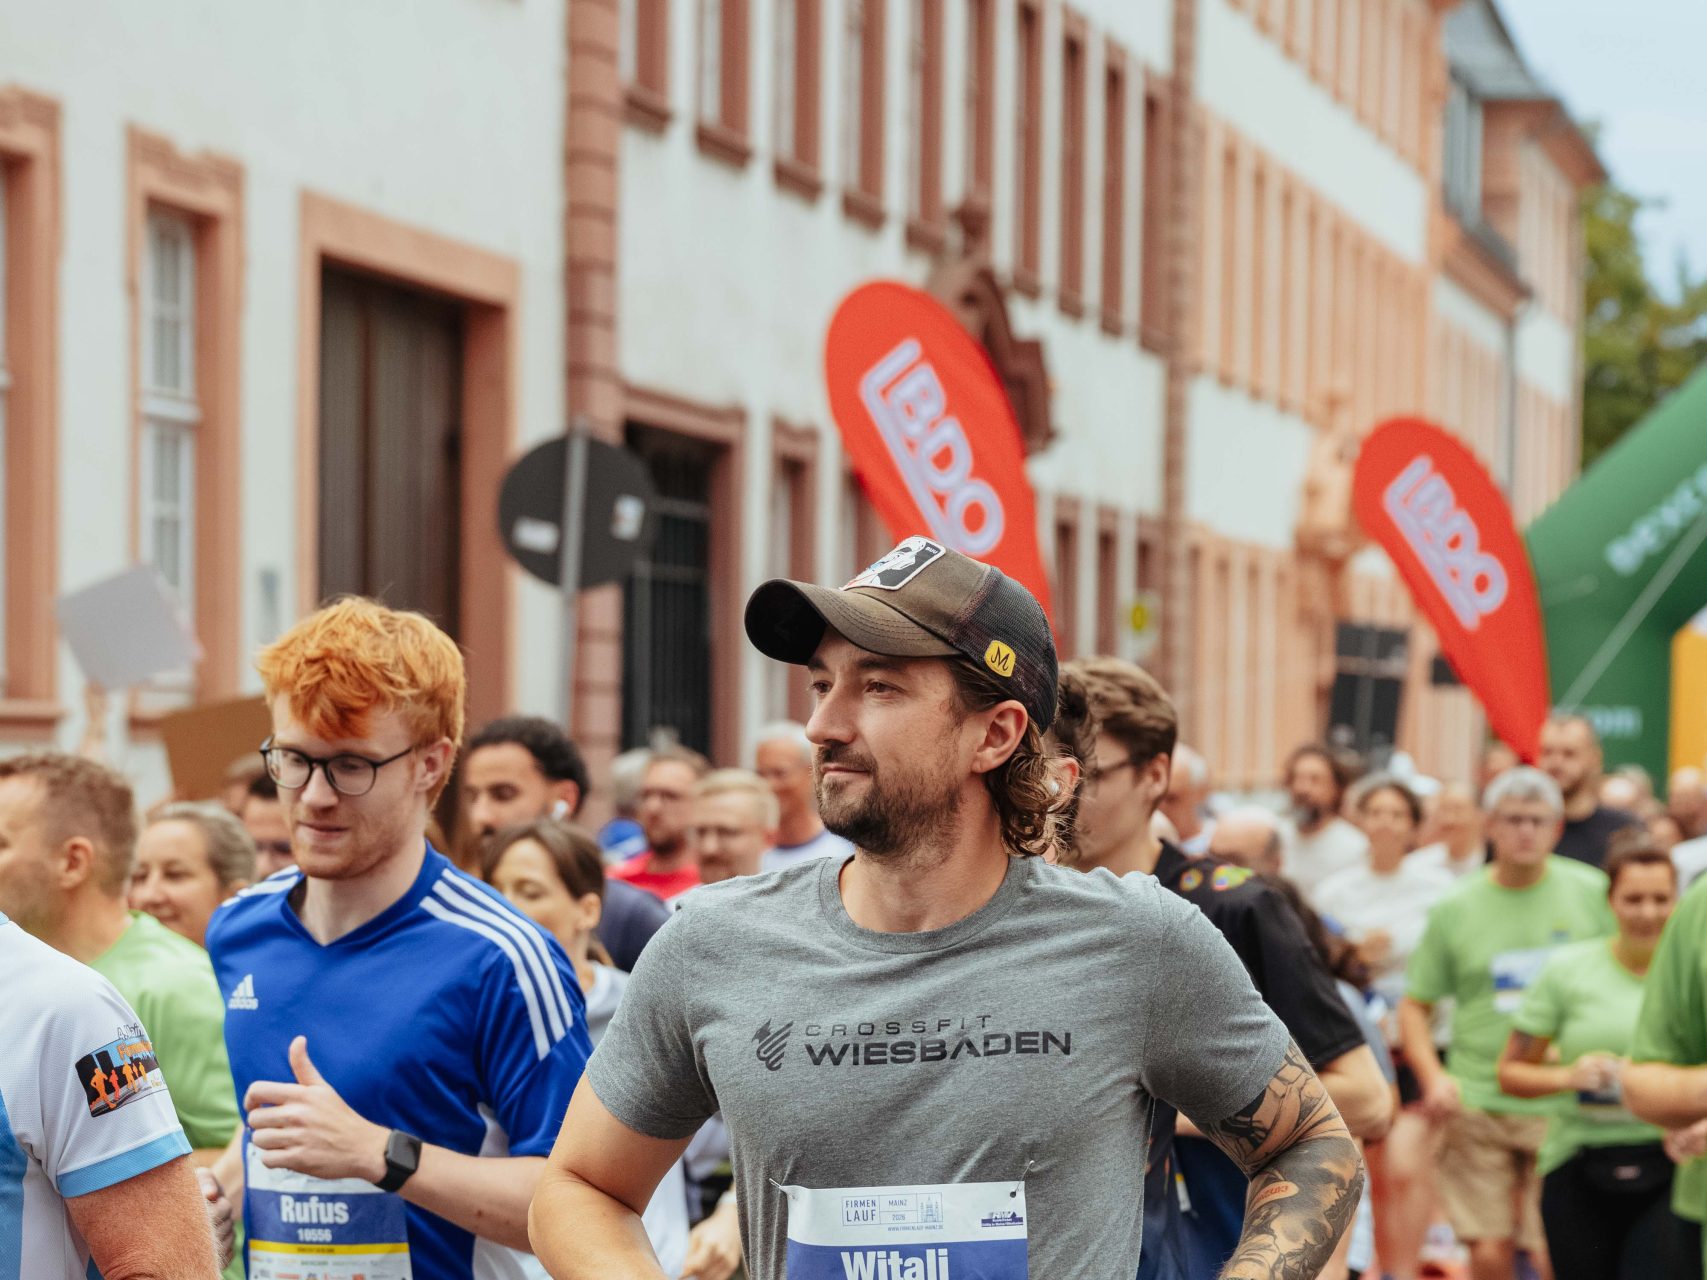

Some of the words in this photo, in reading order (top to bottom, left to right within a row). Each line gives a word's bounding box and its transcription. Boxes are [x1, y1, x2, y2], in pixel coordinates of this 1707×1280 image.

[878, 355, 1005, 555] BDO
[1400, 466, 1508, 617] BDO
[805, 1015, 991, 1037] CROSSFIT
[803, 1031, 1071, 1066] WIESBADEN
[280, 1194, 350, 1224] Rufus
[845, 1199, 876, 1208] FIRMEN
[888, 1199, 907, 1207] MAINZ
[846, 1209, 876, 1222] LAUF
[297, 1228, 332, 1242] 10556
